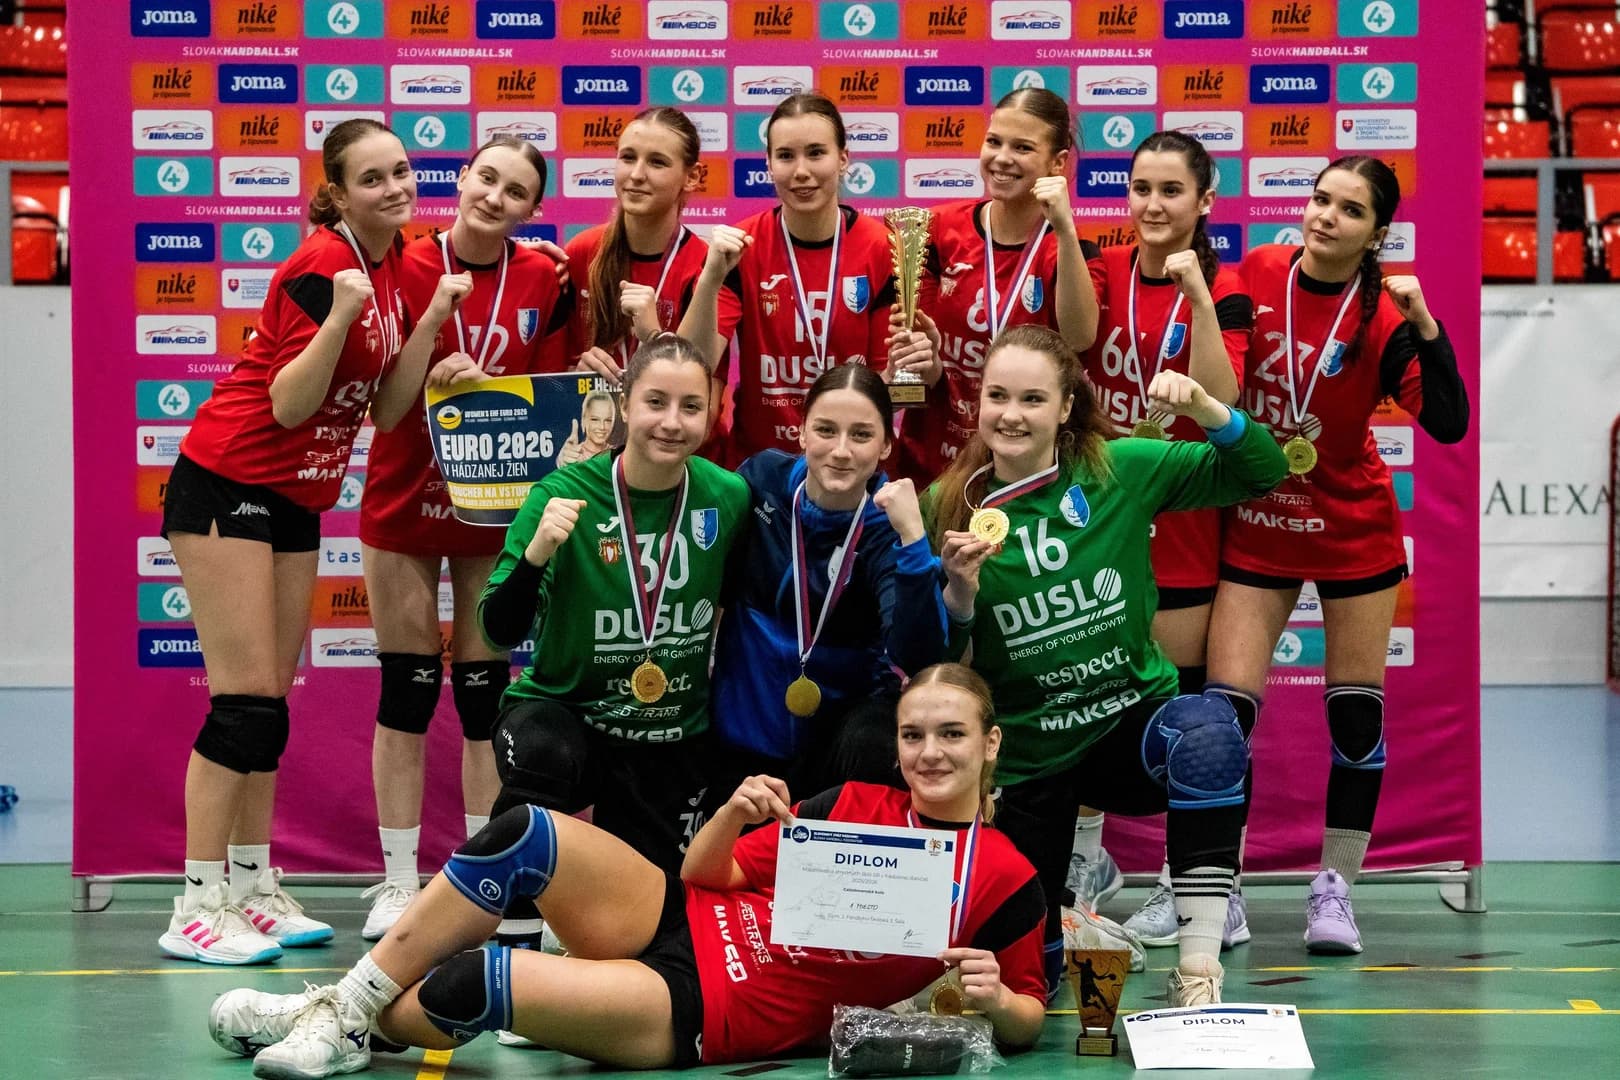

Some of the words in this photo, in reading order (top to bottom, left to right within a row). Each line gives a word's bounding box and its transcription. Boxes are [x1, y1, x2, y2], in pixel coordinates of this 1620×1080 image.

[237, 2, 276, 26] niké
[410, 2, 449, 26] niké
[582, 4, 621, 27] niké
[754, 4, 793, 27] niké
[928, 5, 967, 26] niké
[1098, 5, 1137, 26] niké
[1272, 3, 1311, 25] niké
[182, 45, 299, 57] SLOVAKHANDBALL.SK
[397, 46, 513, 58] SLOVAKHANDBALL.SK
[610, 47, 726, 58] SLOVAKHANDBALL.SK
[822, 47, 939, 58] SLOVAKHANDBALL.SK
[1036, 47, 1152, 58] SLOVAKHANDBALL.SK
[1251, 46, 1369, 57] SLOVAKHANDBALL.SK
[152, 69, 192, 91] niké
[497, 70, 537, 91] niké
[839, 71, 879, 92] niké
[1184, 70, 1223, 90] niké
[240, 116, 280, 137] niké
[583, 115, 623, 137] niké
[925, 117, 965, 137] niké
[1270, 115, 1310, 137] niké
[416, 168, 458, 184] oma
[1088, 170, 1130, 186] Jom
[184, 205, 301, 217] SLOVAKHANDBALL.SK
[156, 272, 197, 295] niké
[440, 433, 494, 462] EURO
[497, 430, 555, 460] 2026
[443, 463, 450, 477] V
[451, 461, 504, 478] HÁDZANEJ
[506, 460, 529, 477] ŽIEN
[326, 549, 361, 564] tas
[1015, 517, 1069, 577] 16
[634, 532, 690, 594] 30
[1009, 643, 1044, 661] ENERGY
[1045, 638, 1060, 651] OF
[1060, 630, 1087, 646] YOUR
[1088, 613, 1127, 636] GROWTH
[594, 654, 632, 665] ENERGY
[670, 645, 704, 659] GROWTH
[834, 852, 898, 869] DIPLOM
[1182, 1017, 1246, 1026] DIPLOM
